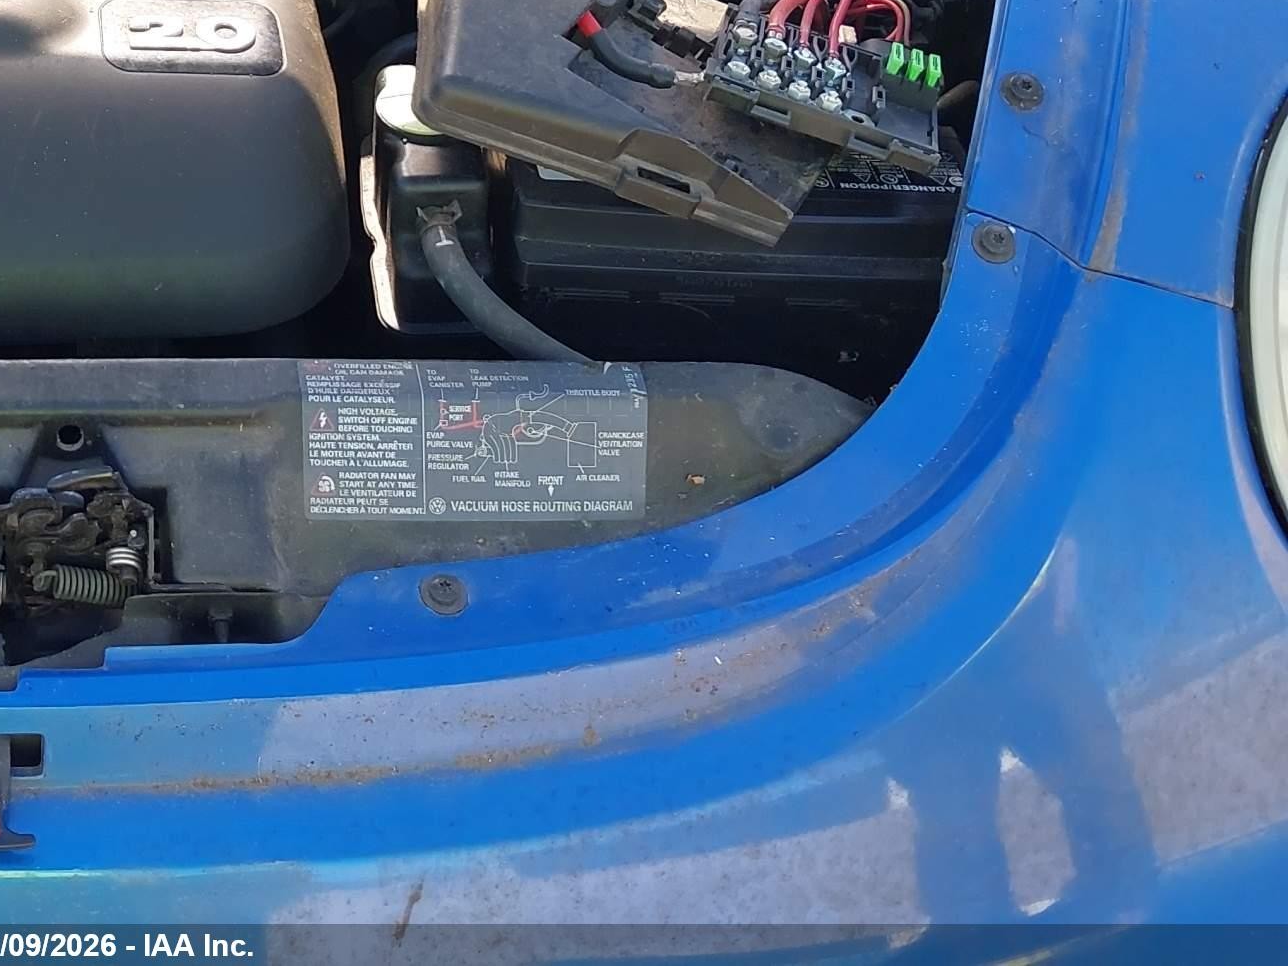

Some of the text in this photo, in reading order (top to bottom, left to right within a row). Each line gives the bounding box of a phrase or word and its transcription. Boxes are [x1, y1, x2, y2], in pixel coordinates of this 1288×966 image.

[334, 362, 381, 370] OVERFILLED
[308, 395, 331, 403] POUR
[338, 416, 369, 424] SWITCH
[388, 417, 418, 425] ENGINE
[338, 425, 413, 433] BEFORE TOUCHING
[308, 433, 346, 441] IGNITION
[309, 442, 337, 450] HAUTE
[377, 440, 414, 451] ARRÊTER
[598, 440, 643, 448] VENTILATION
[309, 450, 396, 459] LE MOTEUR AVANT DE
[349, 457, 355, 466] À
[427, 462, 469, 470] REGULATOR
[338, 472, 417, 480] RADIATOR FAN MAY
[471, 475, 487, 483] RAIL
[537, 475, 564, 485] FRONT
[575, 474, 621, 482] AIR CLEANER
[378, 481, 396, 489] ANY
[494, 480, 531, 488] MANIFOLD
[339, 489, 350, 497] LE
[407, 490, 417, 498] DE
[310, 497, 390, 506] RADIATEUR PEUT SE
[310, 505, 359, 514] DÉCLENCHER
[368, 506, 387, 514] TOUT
[451, 500, 499, 512] VACUUM
[501, 500, 531, 512] HOSE
[532, 500, 582, 512] ROUTING
[584, 500, 633, 512] DIAGRAM
